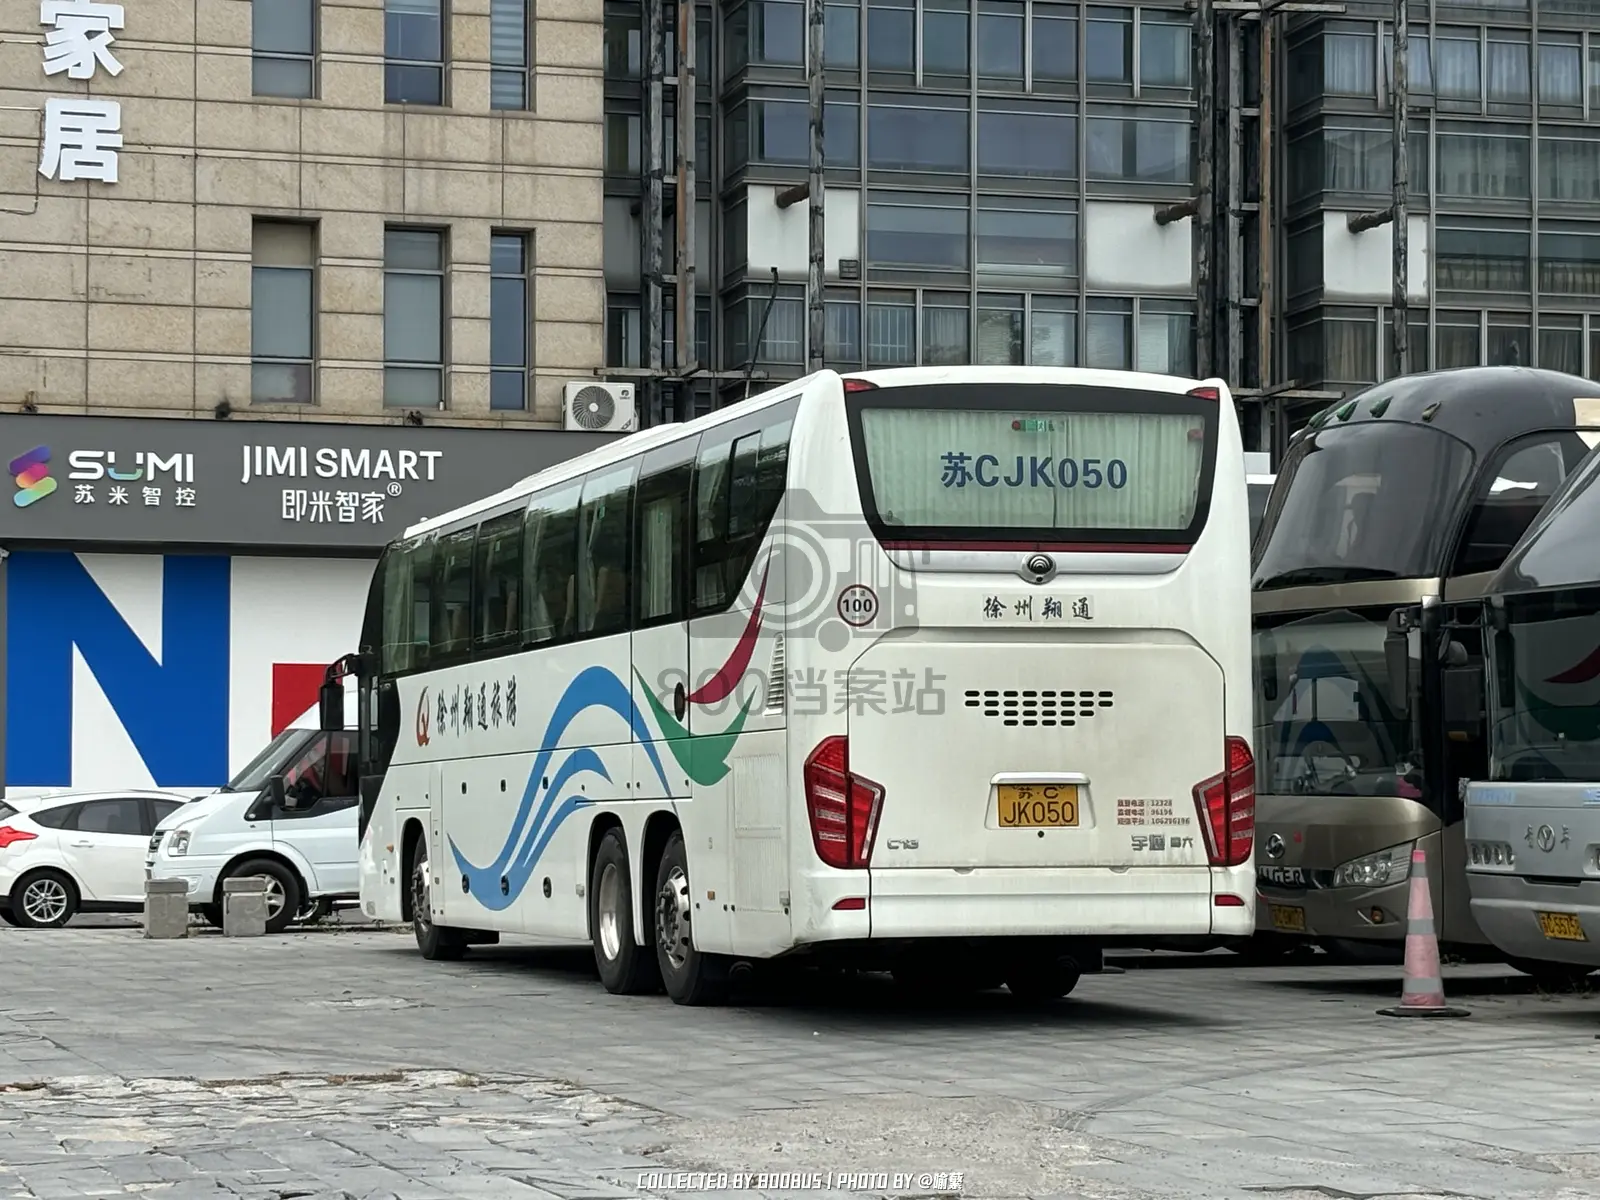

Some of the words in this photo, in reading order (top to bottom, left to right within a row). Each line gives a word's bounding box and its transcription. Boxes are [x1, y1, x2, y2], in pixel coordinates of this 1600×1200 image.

[38, 0, 125, 183] 家居
[68, 450, 194, 483] SUMI
[241, 445, 308, 484] JIMI
[314, 447, 443, 481] SMART
[940, 451, 1128, 490] 苏CJK050
[74, 484, 197, 507] 苏米智控
[842, 598, 873, 613] 100
[983, 595, 1095, 621] 徐州翔通
[1004, 801, 1075, 824] JK050
